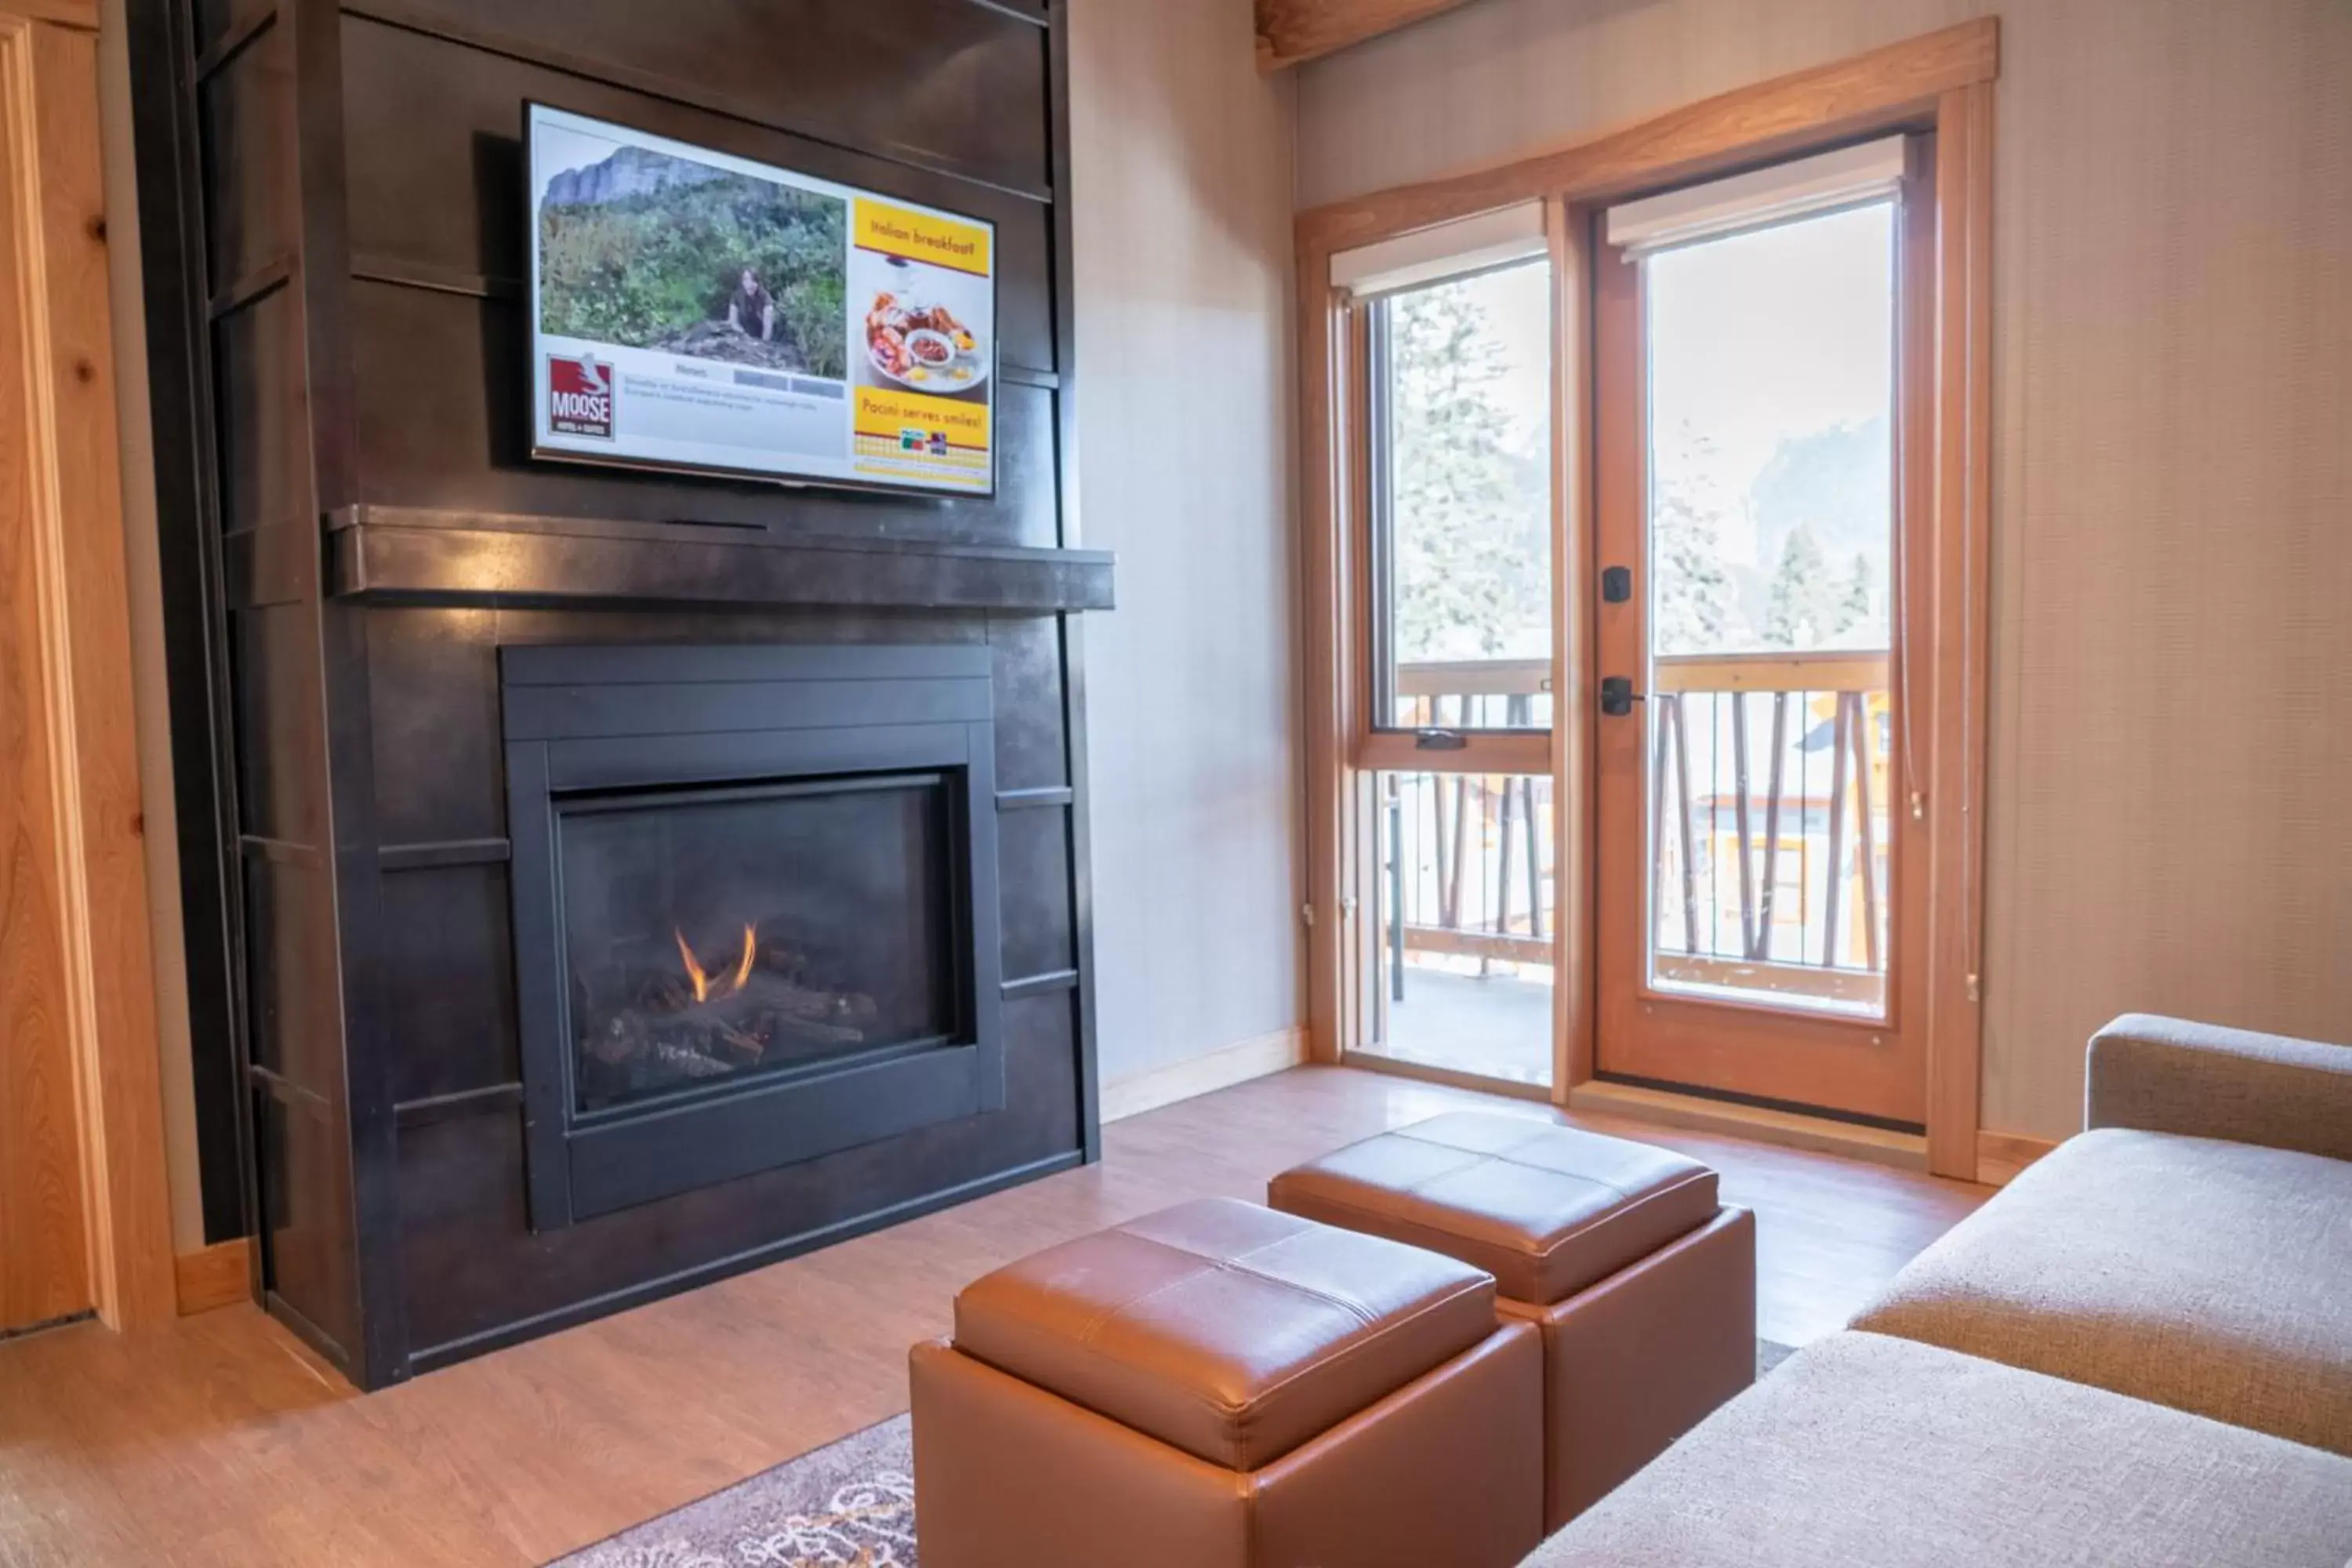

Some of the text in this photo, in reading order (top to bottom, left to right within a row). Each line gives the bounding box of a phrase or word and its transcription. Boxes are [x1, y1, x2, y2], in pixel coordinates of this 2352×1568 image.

[871, 220, 909, 239] Italian
[553, 390, 609, 423] MOOSE
[903, 408, 941, 423] serves
